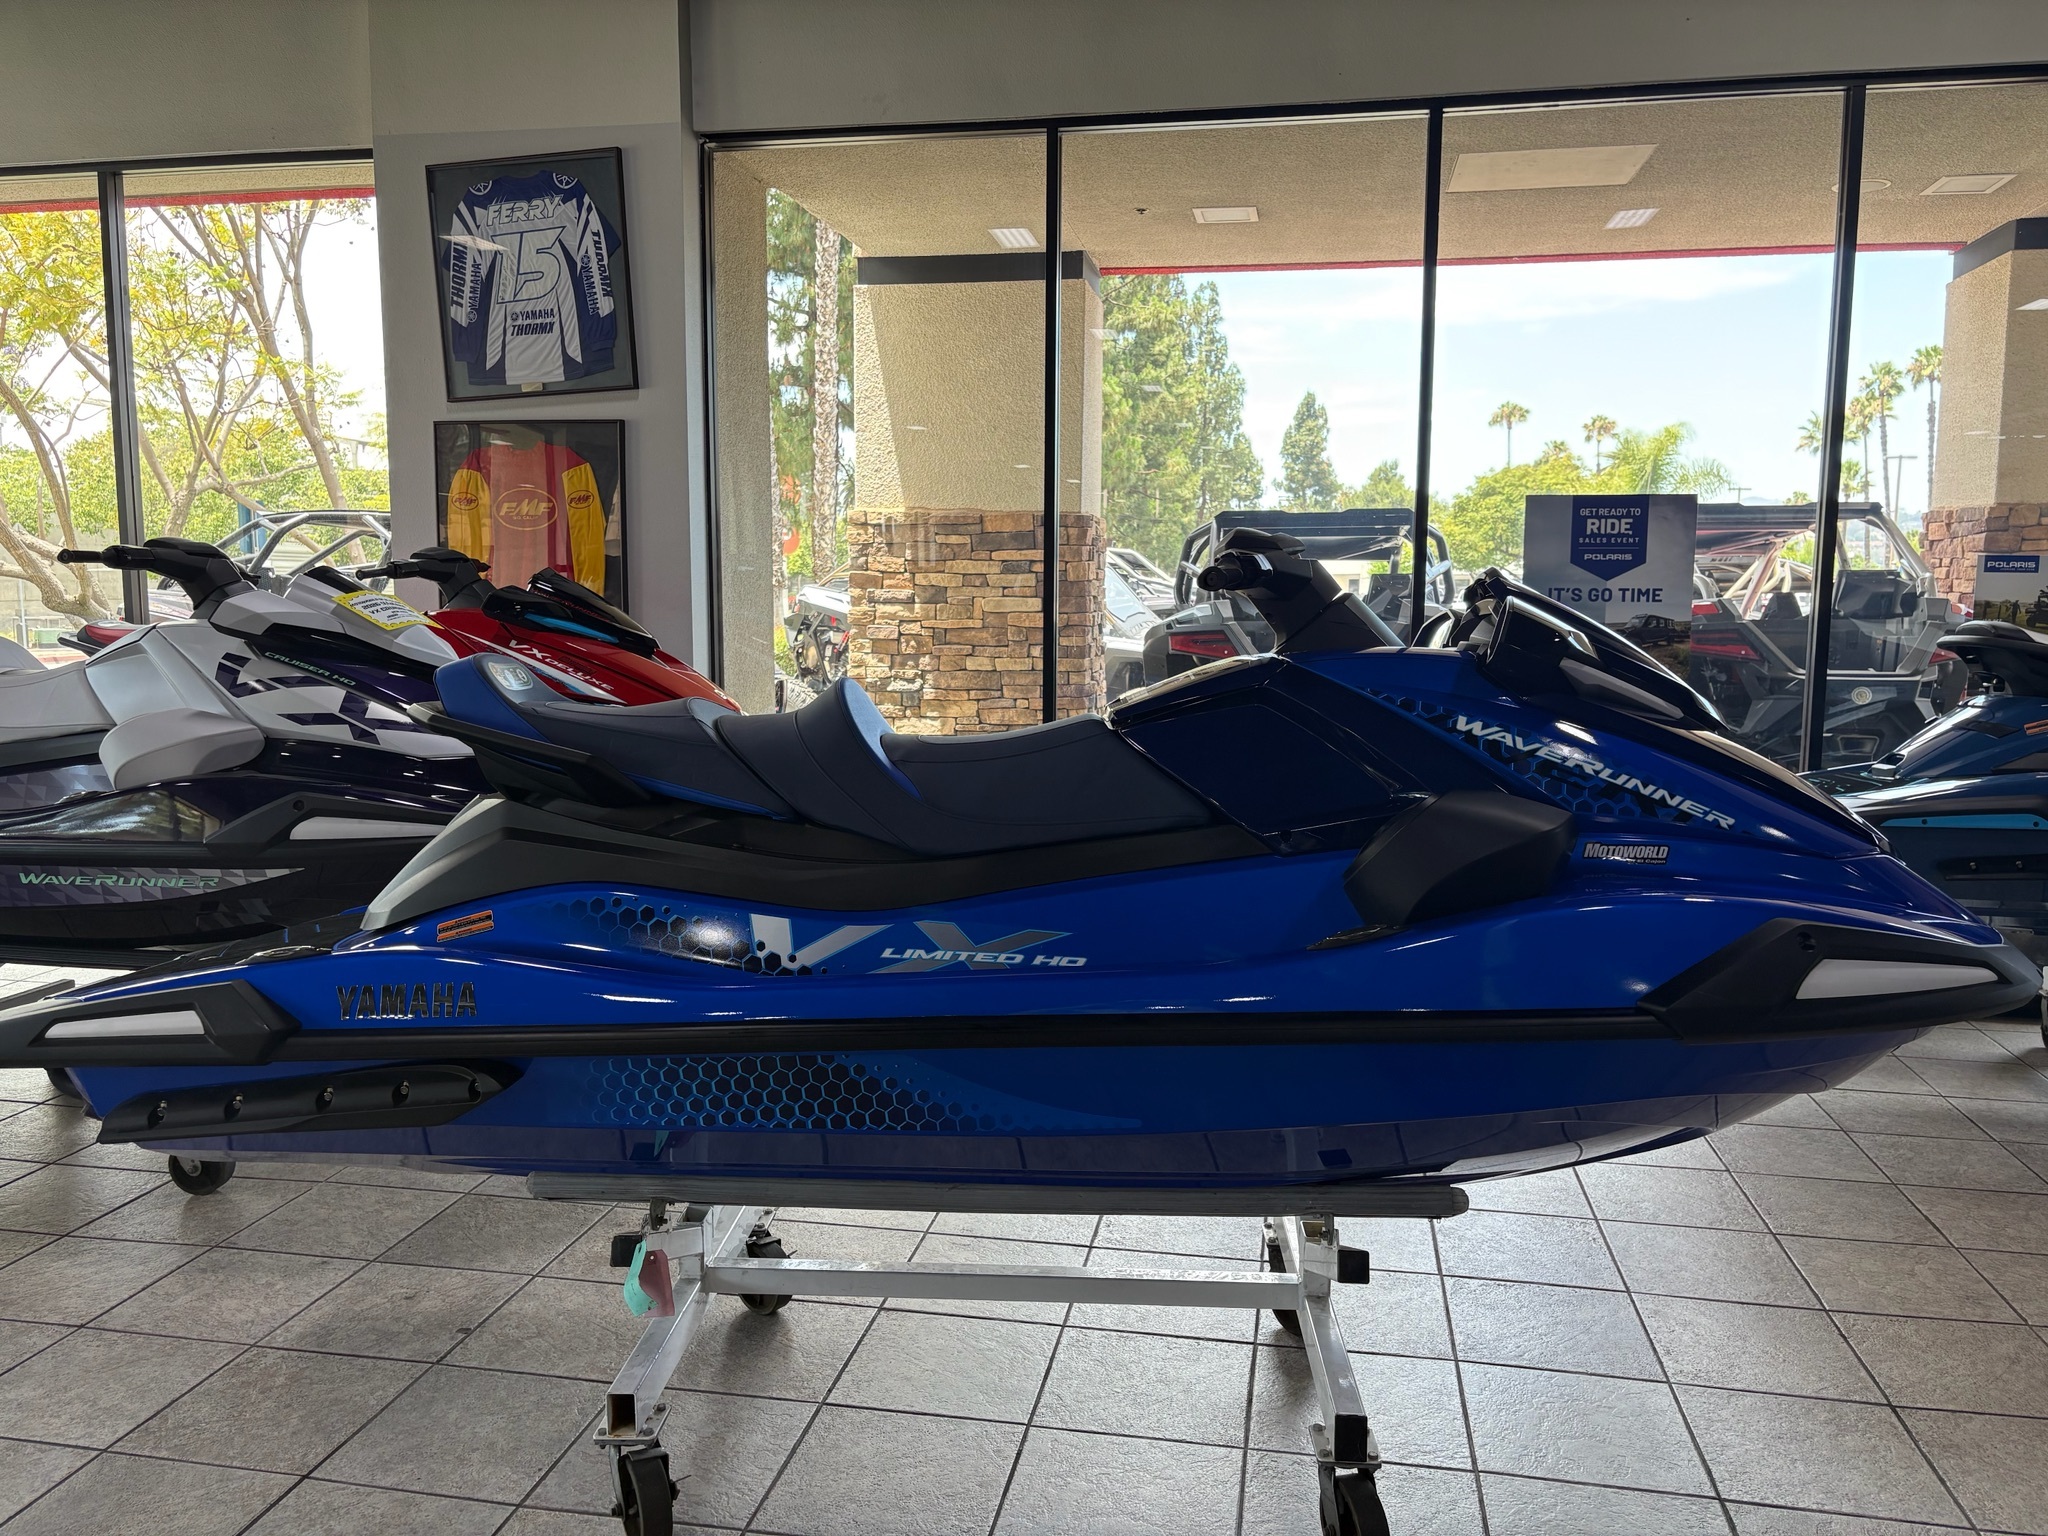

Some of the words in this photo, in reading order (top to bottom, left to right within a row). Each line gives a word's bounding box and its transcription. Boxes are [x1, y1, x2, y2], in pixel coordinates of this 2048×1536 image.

[487, 195, 564, 227] FERRY
[490, 225, 567, 304] 15
[468, 262, 482, 309] YAMAHA
[582, 265, 600, 315] YAMAHA
[520, 308, 555, 321] YAMAHA
[511, 321, 556, 337] THORMX
[499, 498, 554, 516] FMF
[569, 494, 592, 505] FMF
[1579, 508, 1597, 516] GET
[1598, 508, 1628, 516] READY
[1629, 508, 1641, 516] TO
[1586, 518, 1633, 535] RIDE
[1584, 553, 1633, 561] POLARIS
[1548, 587, 1583, 602] IT'S
[1587, 587, 1613, 603] GO
[1618, 587, 1663, 603] TIME
[264, 651, 331, 677] CRUISER
[508, 639, 552, 660] VX
[544, 657, 615, 691] DELUXE
[1456, 714, 1736, 830] WAVERUNNER
[750, 913, 1073, 976] VX
[880, 947, 1025, 965] LIMITED
[336, 981, 477, 1020] YAMAHA
